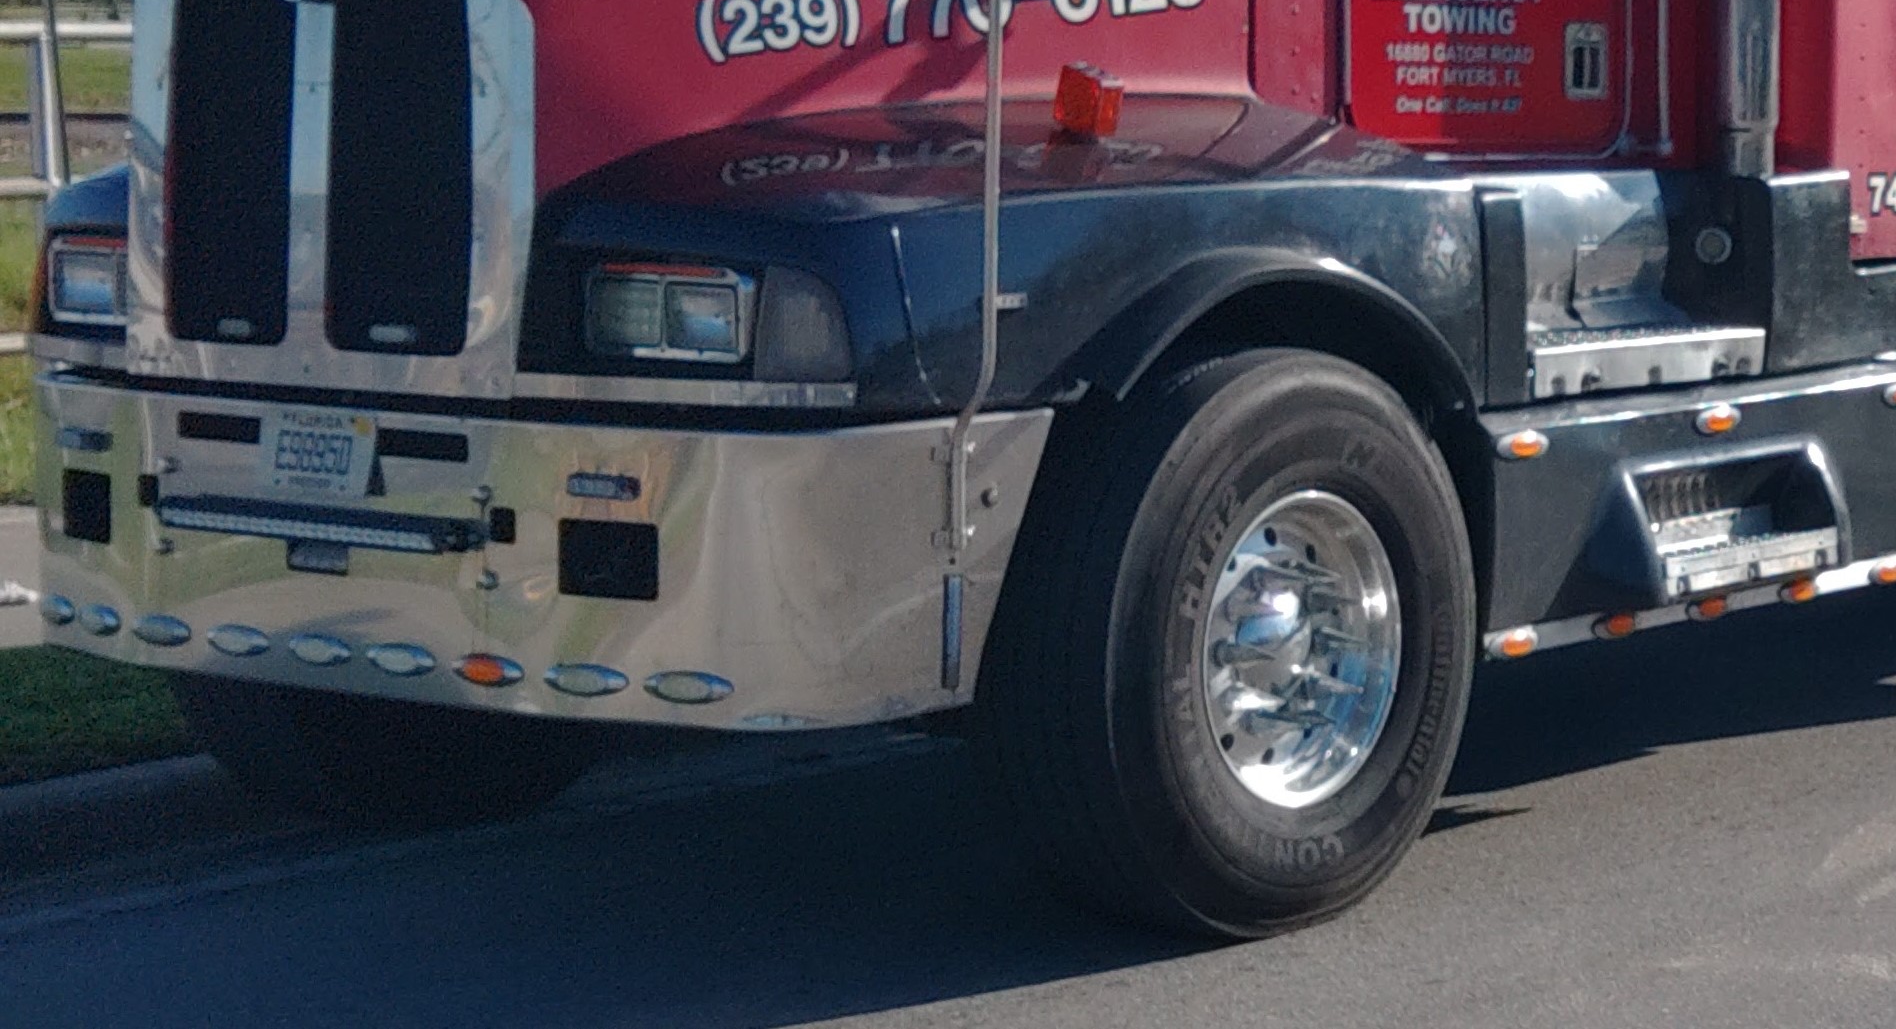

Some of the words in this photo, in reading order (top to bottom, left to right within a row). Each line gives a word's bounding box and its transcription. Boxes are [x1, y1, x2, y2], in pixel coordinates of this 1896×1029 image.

[1403, 3, 1516, 34] TOWING
[1433, 43, 1487, 63] GATOR
[1396, 66, 1440, 85] FORT
[1504, 68, 1522, 87] FL
